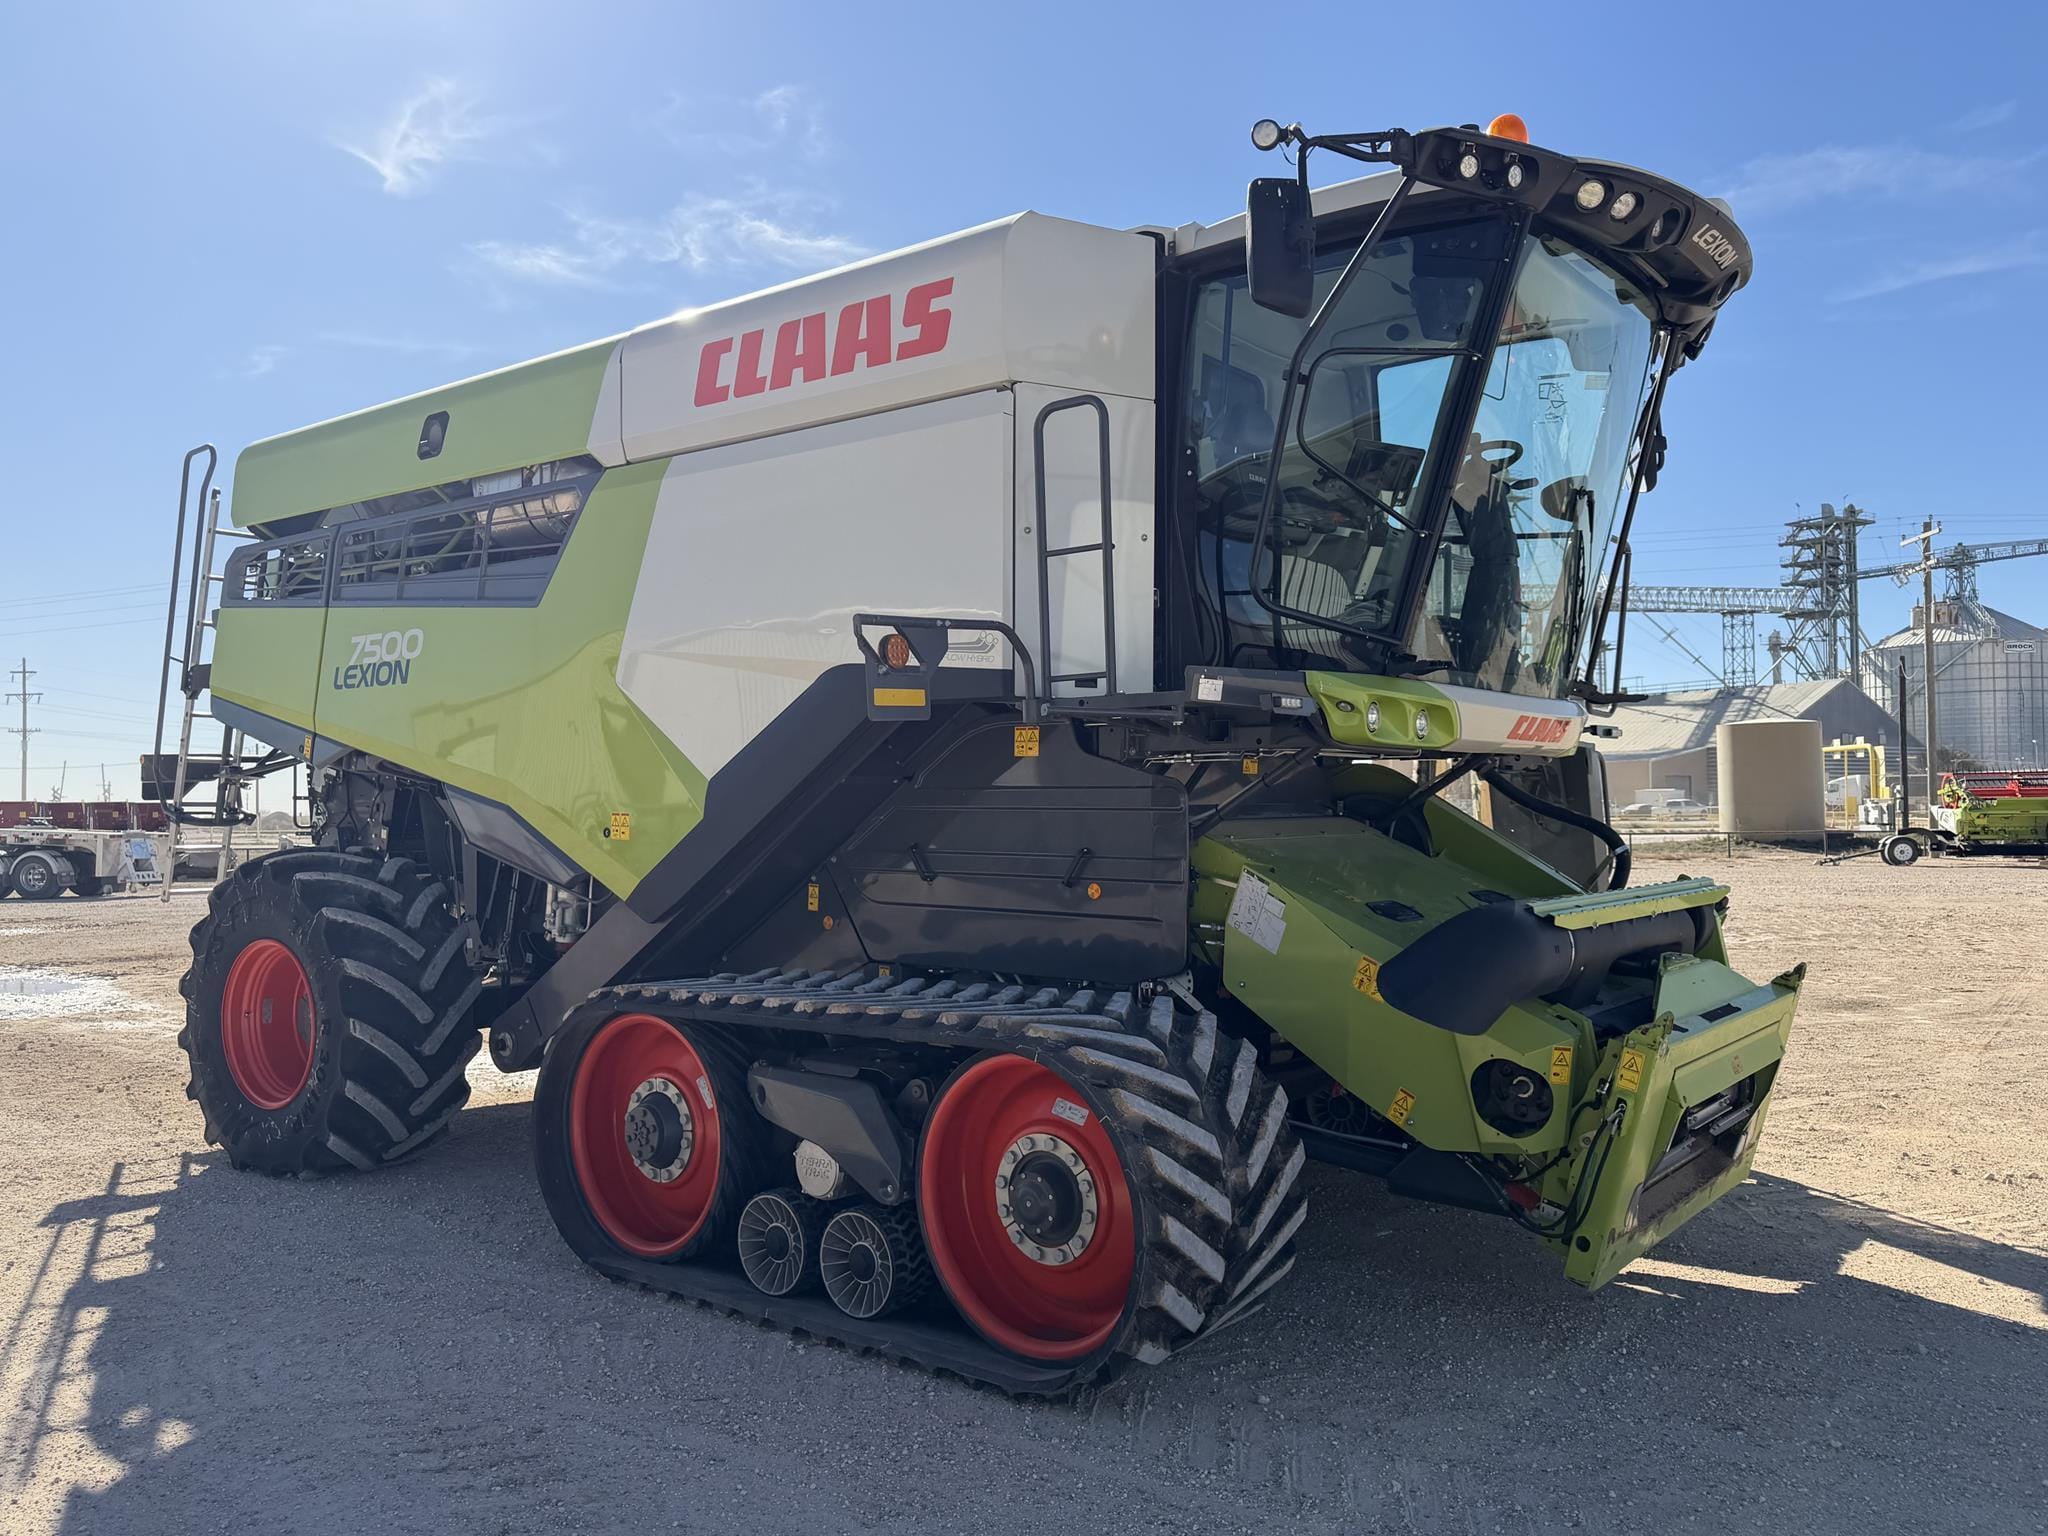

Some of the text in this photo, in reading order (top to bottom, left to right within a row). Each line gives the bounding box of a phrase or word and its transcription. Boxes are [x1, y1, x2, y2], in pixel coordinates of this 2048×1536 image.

[1692, 223, 1738, 270] LEXION
[694, 276, 955, 408] CLAAS
[347, 628, 424, 665] 7500
[333, 659, 411, 690] LEXION
[1506, 714, 1572, 743] CLAAS
